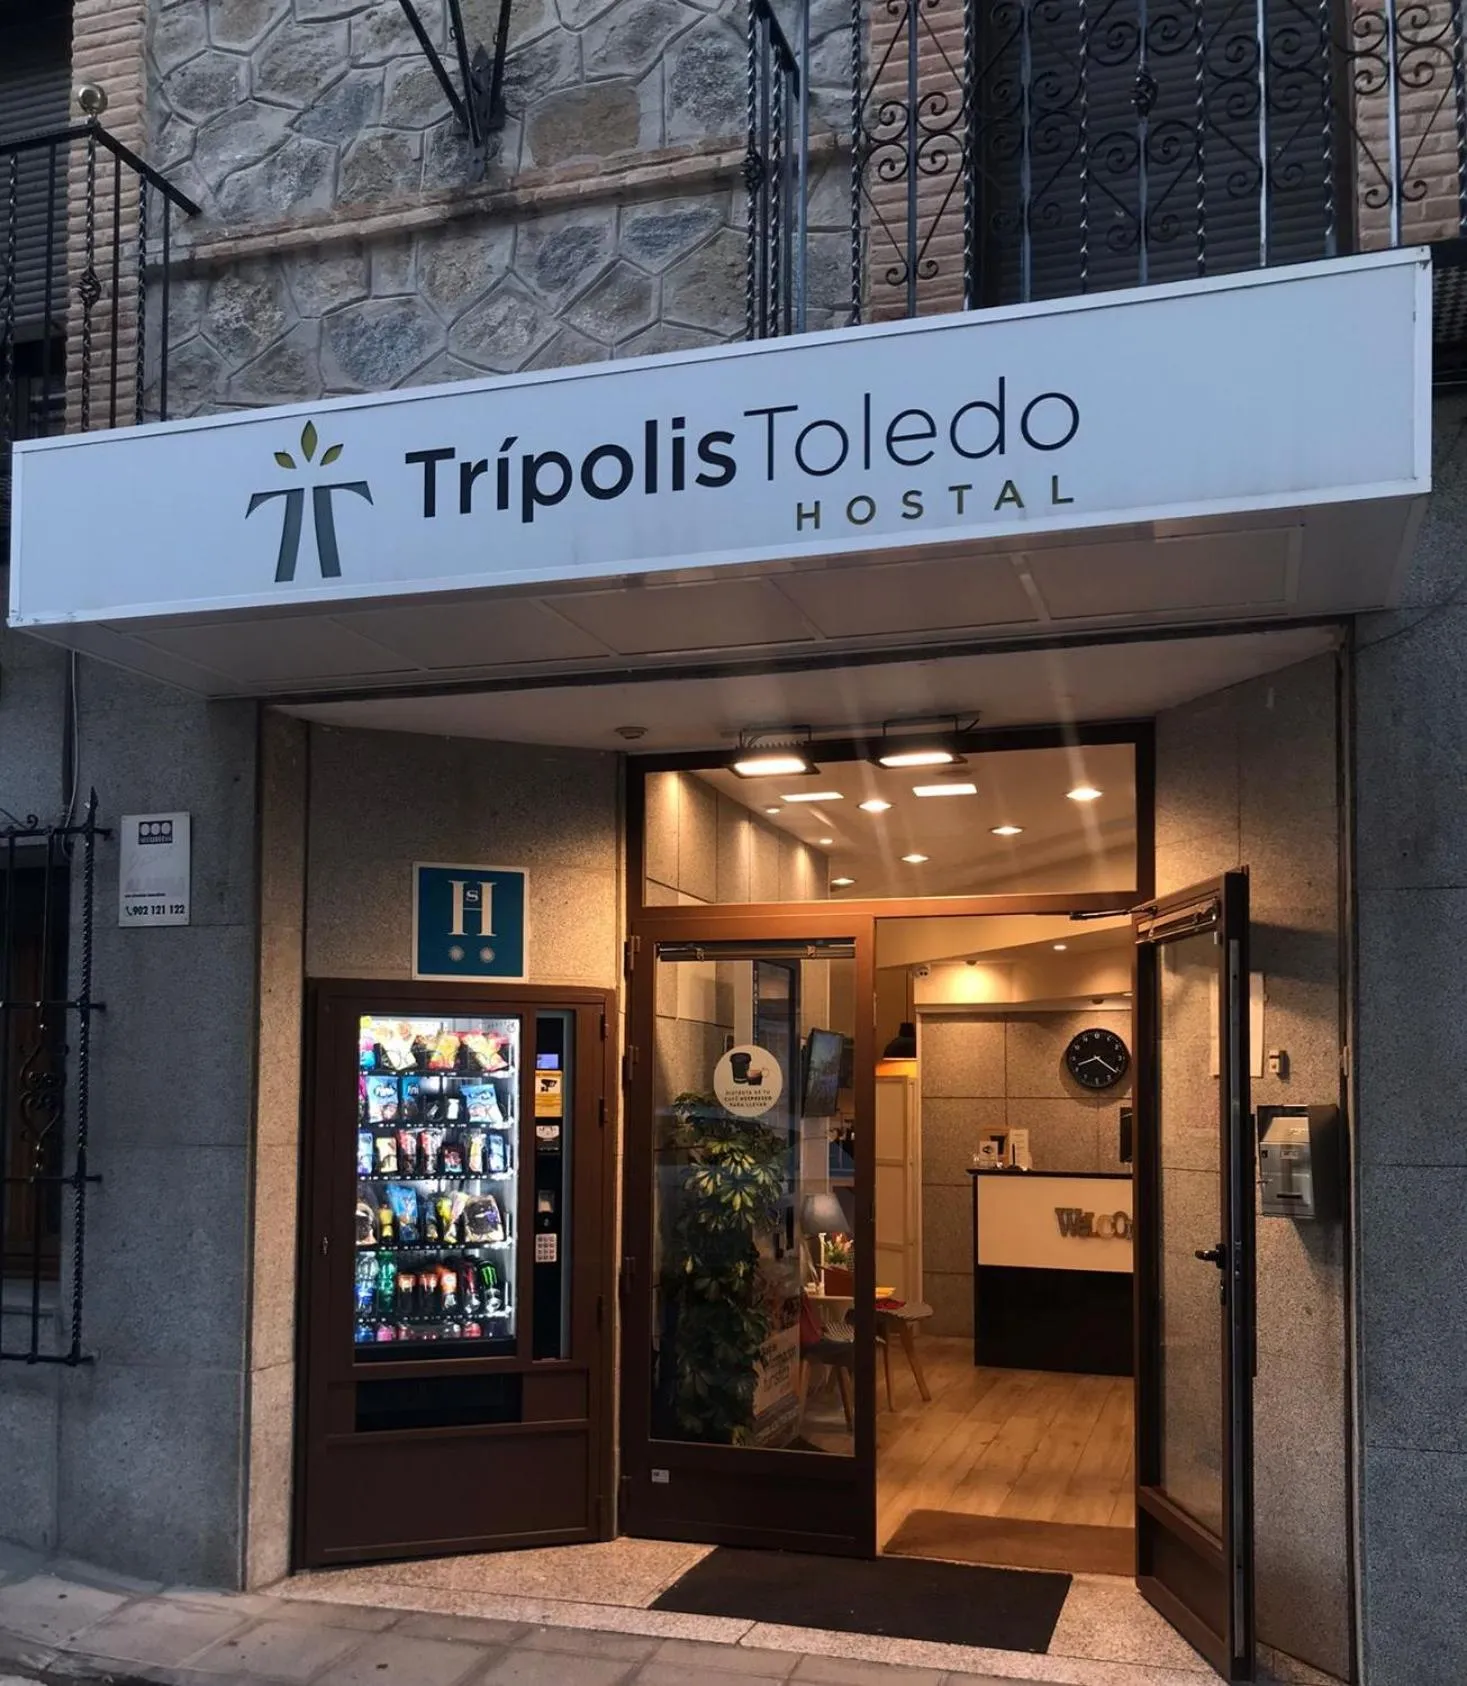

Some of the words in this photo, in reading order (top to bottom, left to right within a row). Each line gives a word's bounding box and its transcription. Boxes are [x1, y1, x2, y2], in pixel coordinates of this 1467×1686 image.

[405, 416, 737, 524] Trípolis
[743, 375, 1081, 482] Toledo
[796, 474, 1076, 532] HOSTAL
[151, 904, 166, 915] 121
[169, 903, 186, 915] 122
